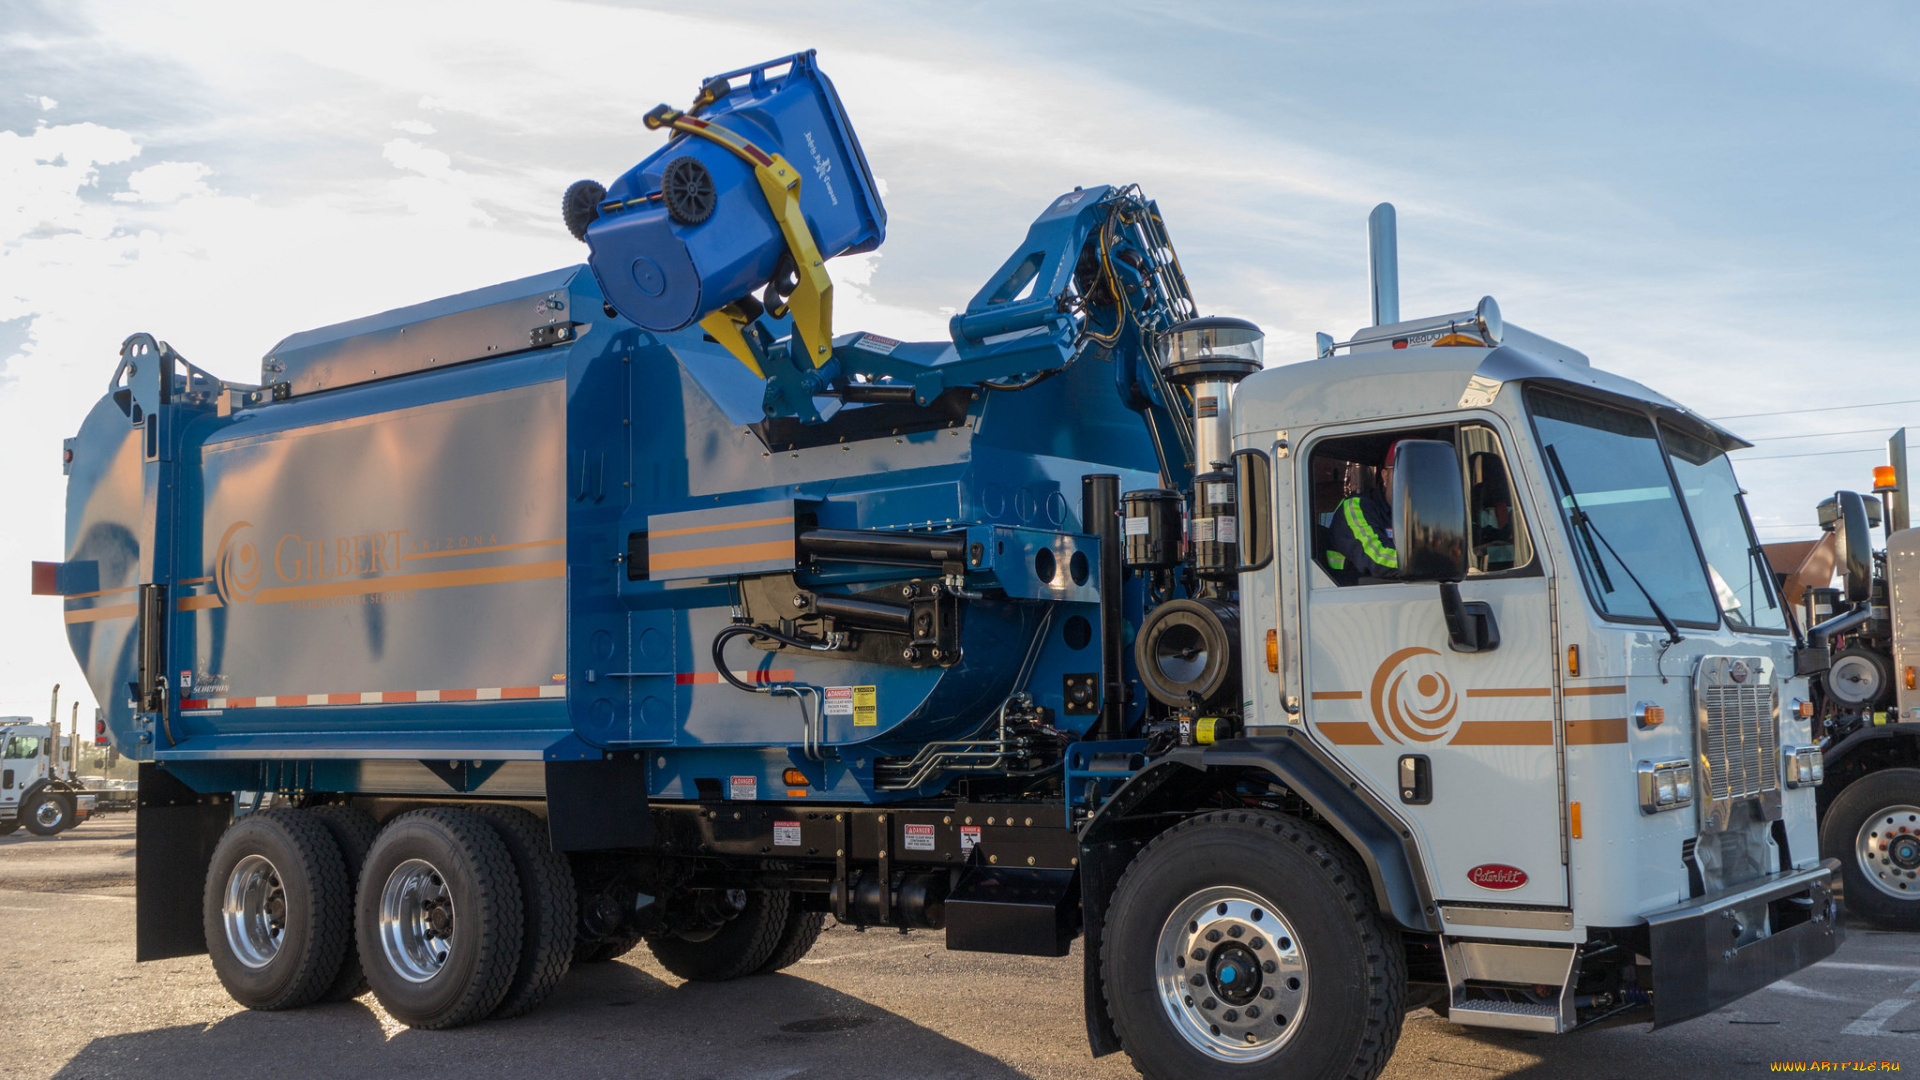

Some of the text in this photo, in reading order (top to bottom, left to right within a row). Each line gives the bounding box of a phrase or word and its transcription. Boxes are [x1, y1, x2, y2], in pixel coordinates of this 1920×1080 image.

[412, 533, 498, 552] ARIZONA
[274, 528, 408, 583] GILBERT
[289, 591, 416, 611] ENVIRONMENTAL SERVICES
[1474, 867, 1523, 883] Peterbilt
